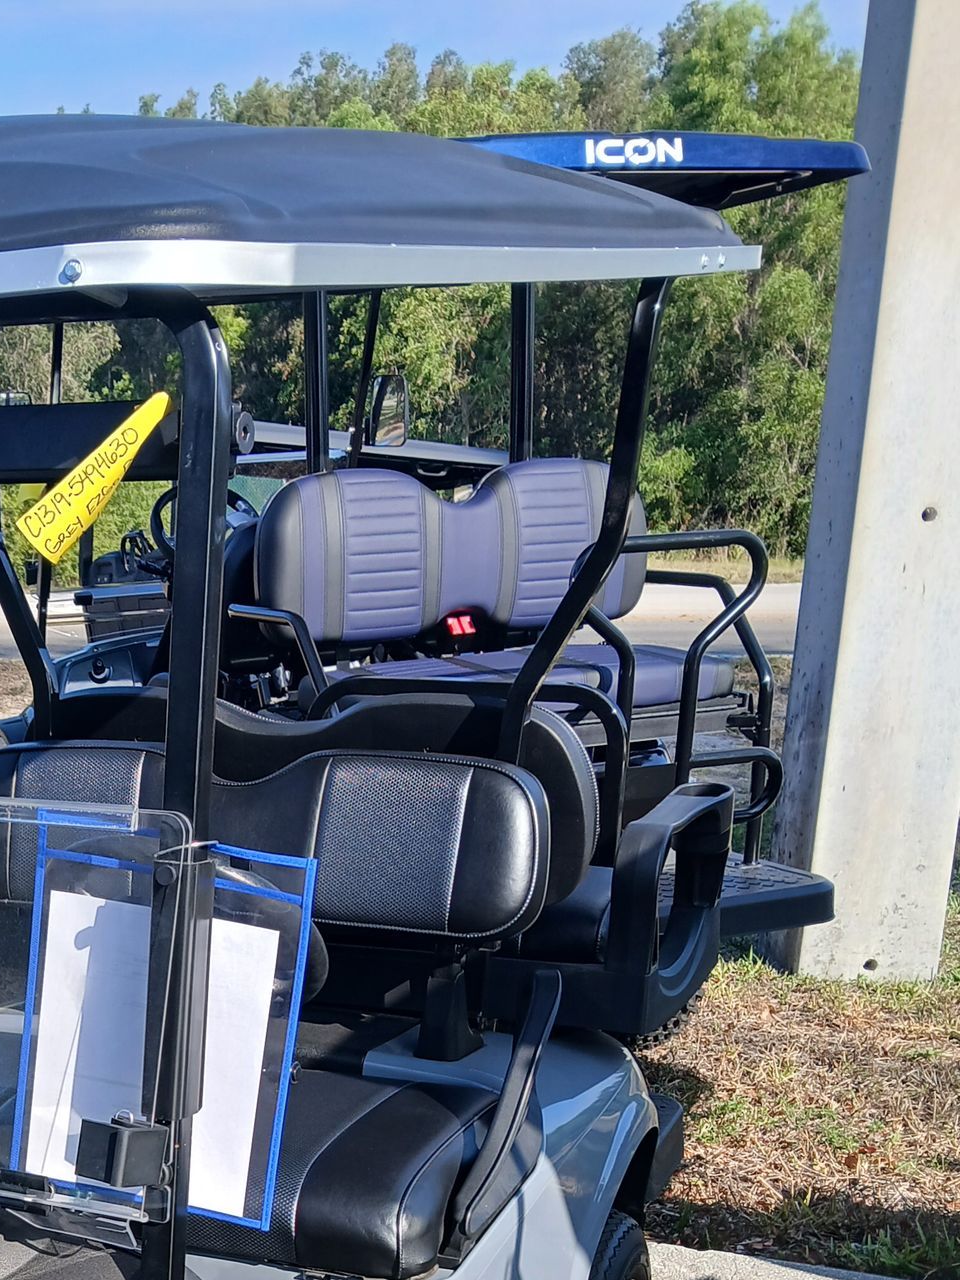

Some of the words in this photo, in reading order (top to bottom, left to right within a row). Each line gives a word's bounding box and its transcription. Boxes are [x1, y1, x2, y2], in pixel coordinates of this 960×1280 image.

[585, 138, 683, 165] ICON
[24, 428, 138, 538] C1319-5494630
[44, 515, 83, 554] GREY
